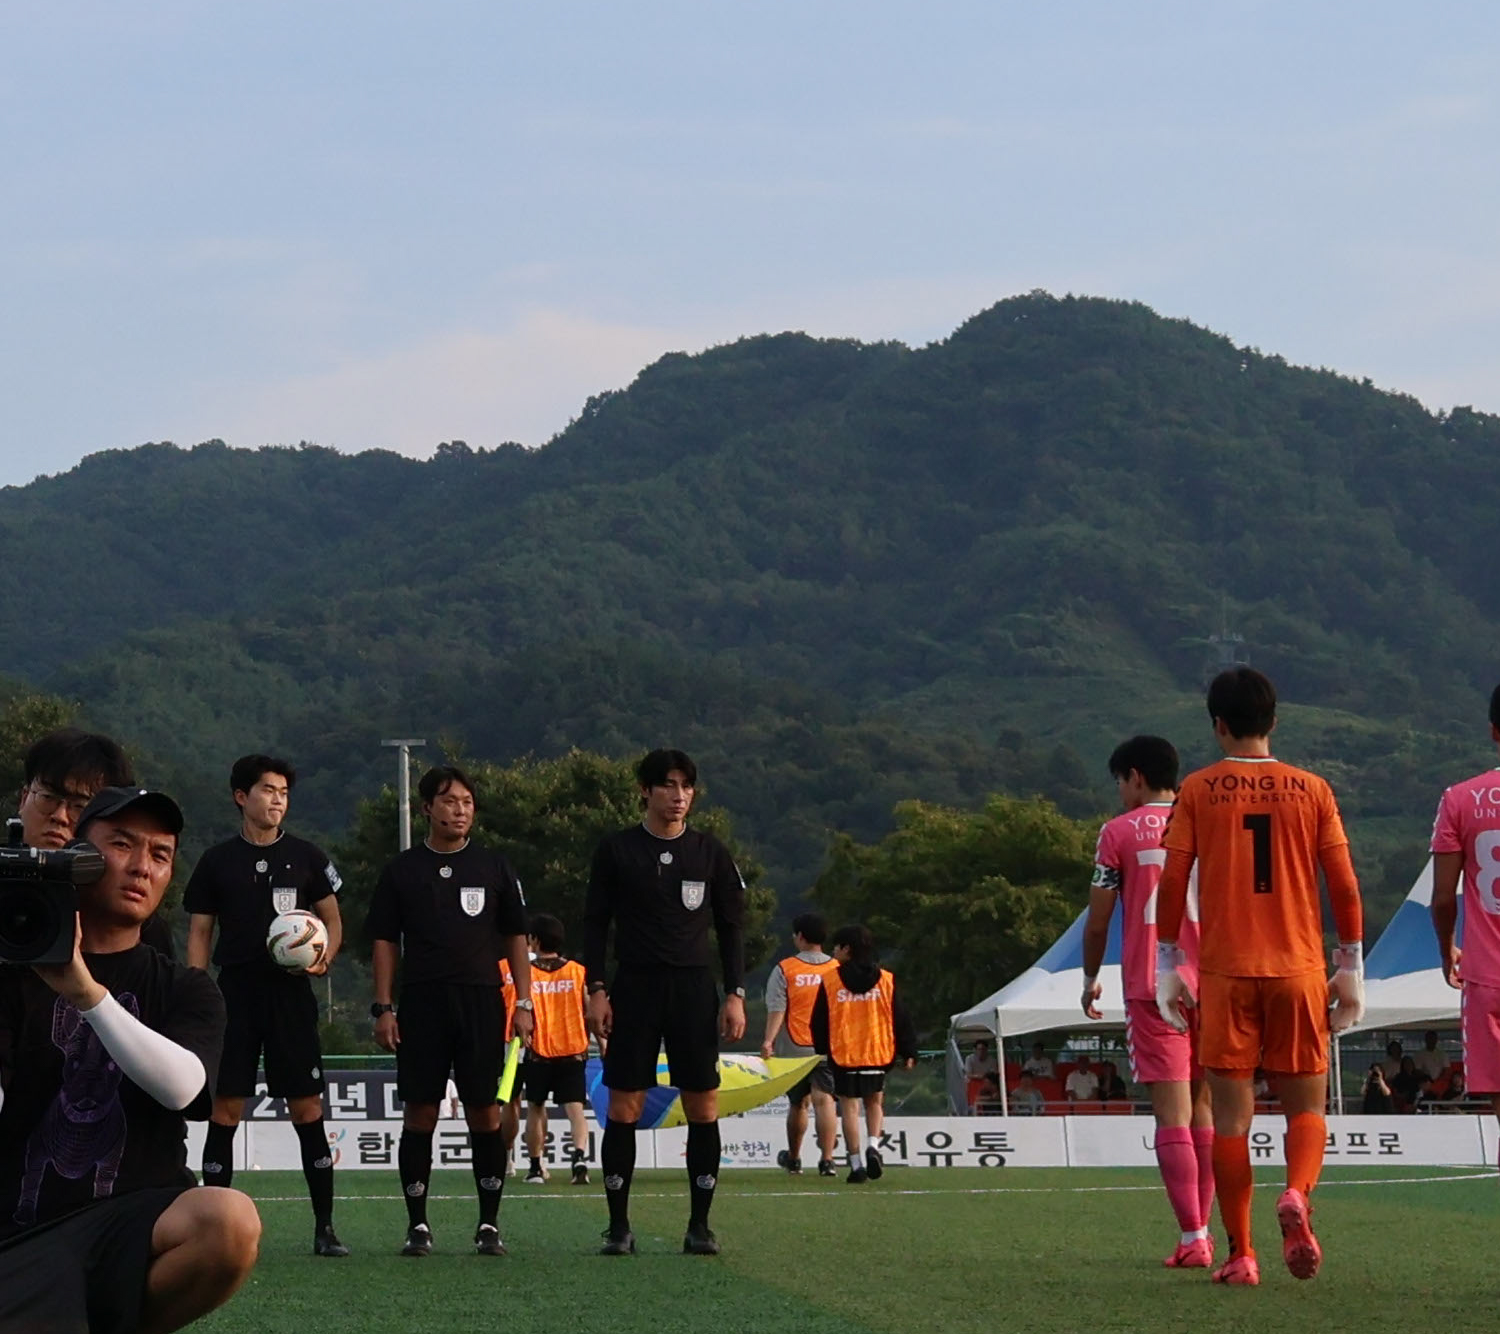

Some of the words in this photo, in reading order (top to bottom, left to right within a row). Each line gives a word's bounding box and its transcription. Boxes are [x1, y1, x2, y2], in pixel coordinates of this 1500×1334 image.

[1203, 774, 1275, 793] YONG
[1284, 775, 1306, 792] IN
[1209, 792, 1306, 805] UNIVERSITY
[1243, 813, 1273, 894] 1
[532, 979, 574, 994] STAFF
[795, 973, 822, 987] STA
